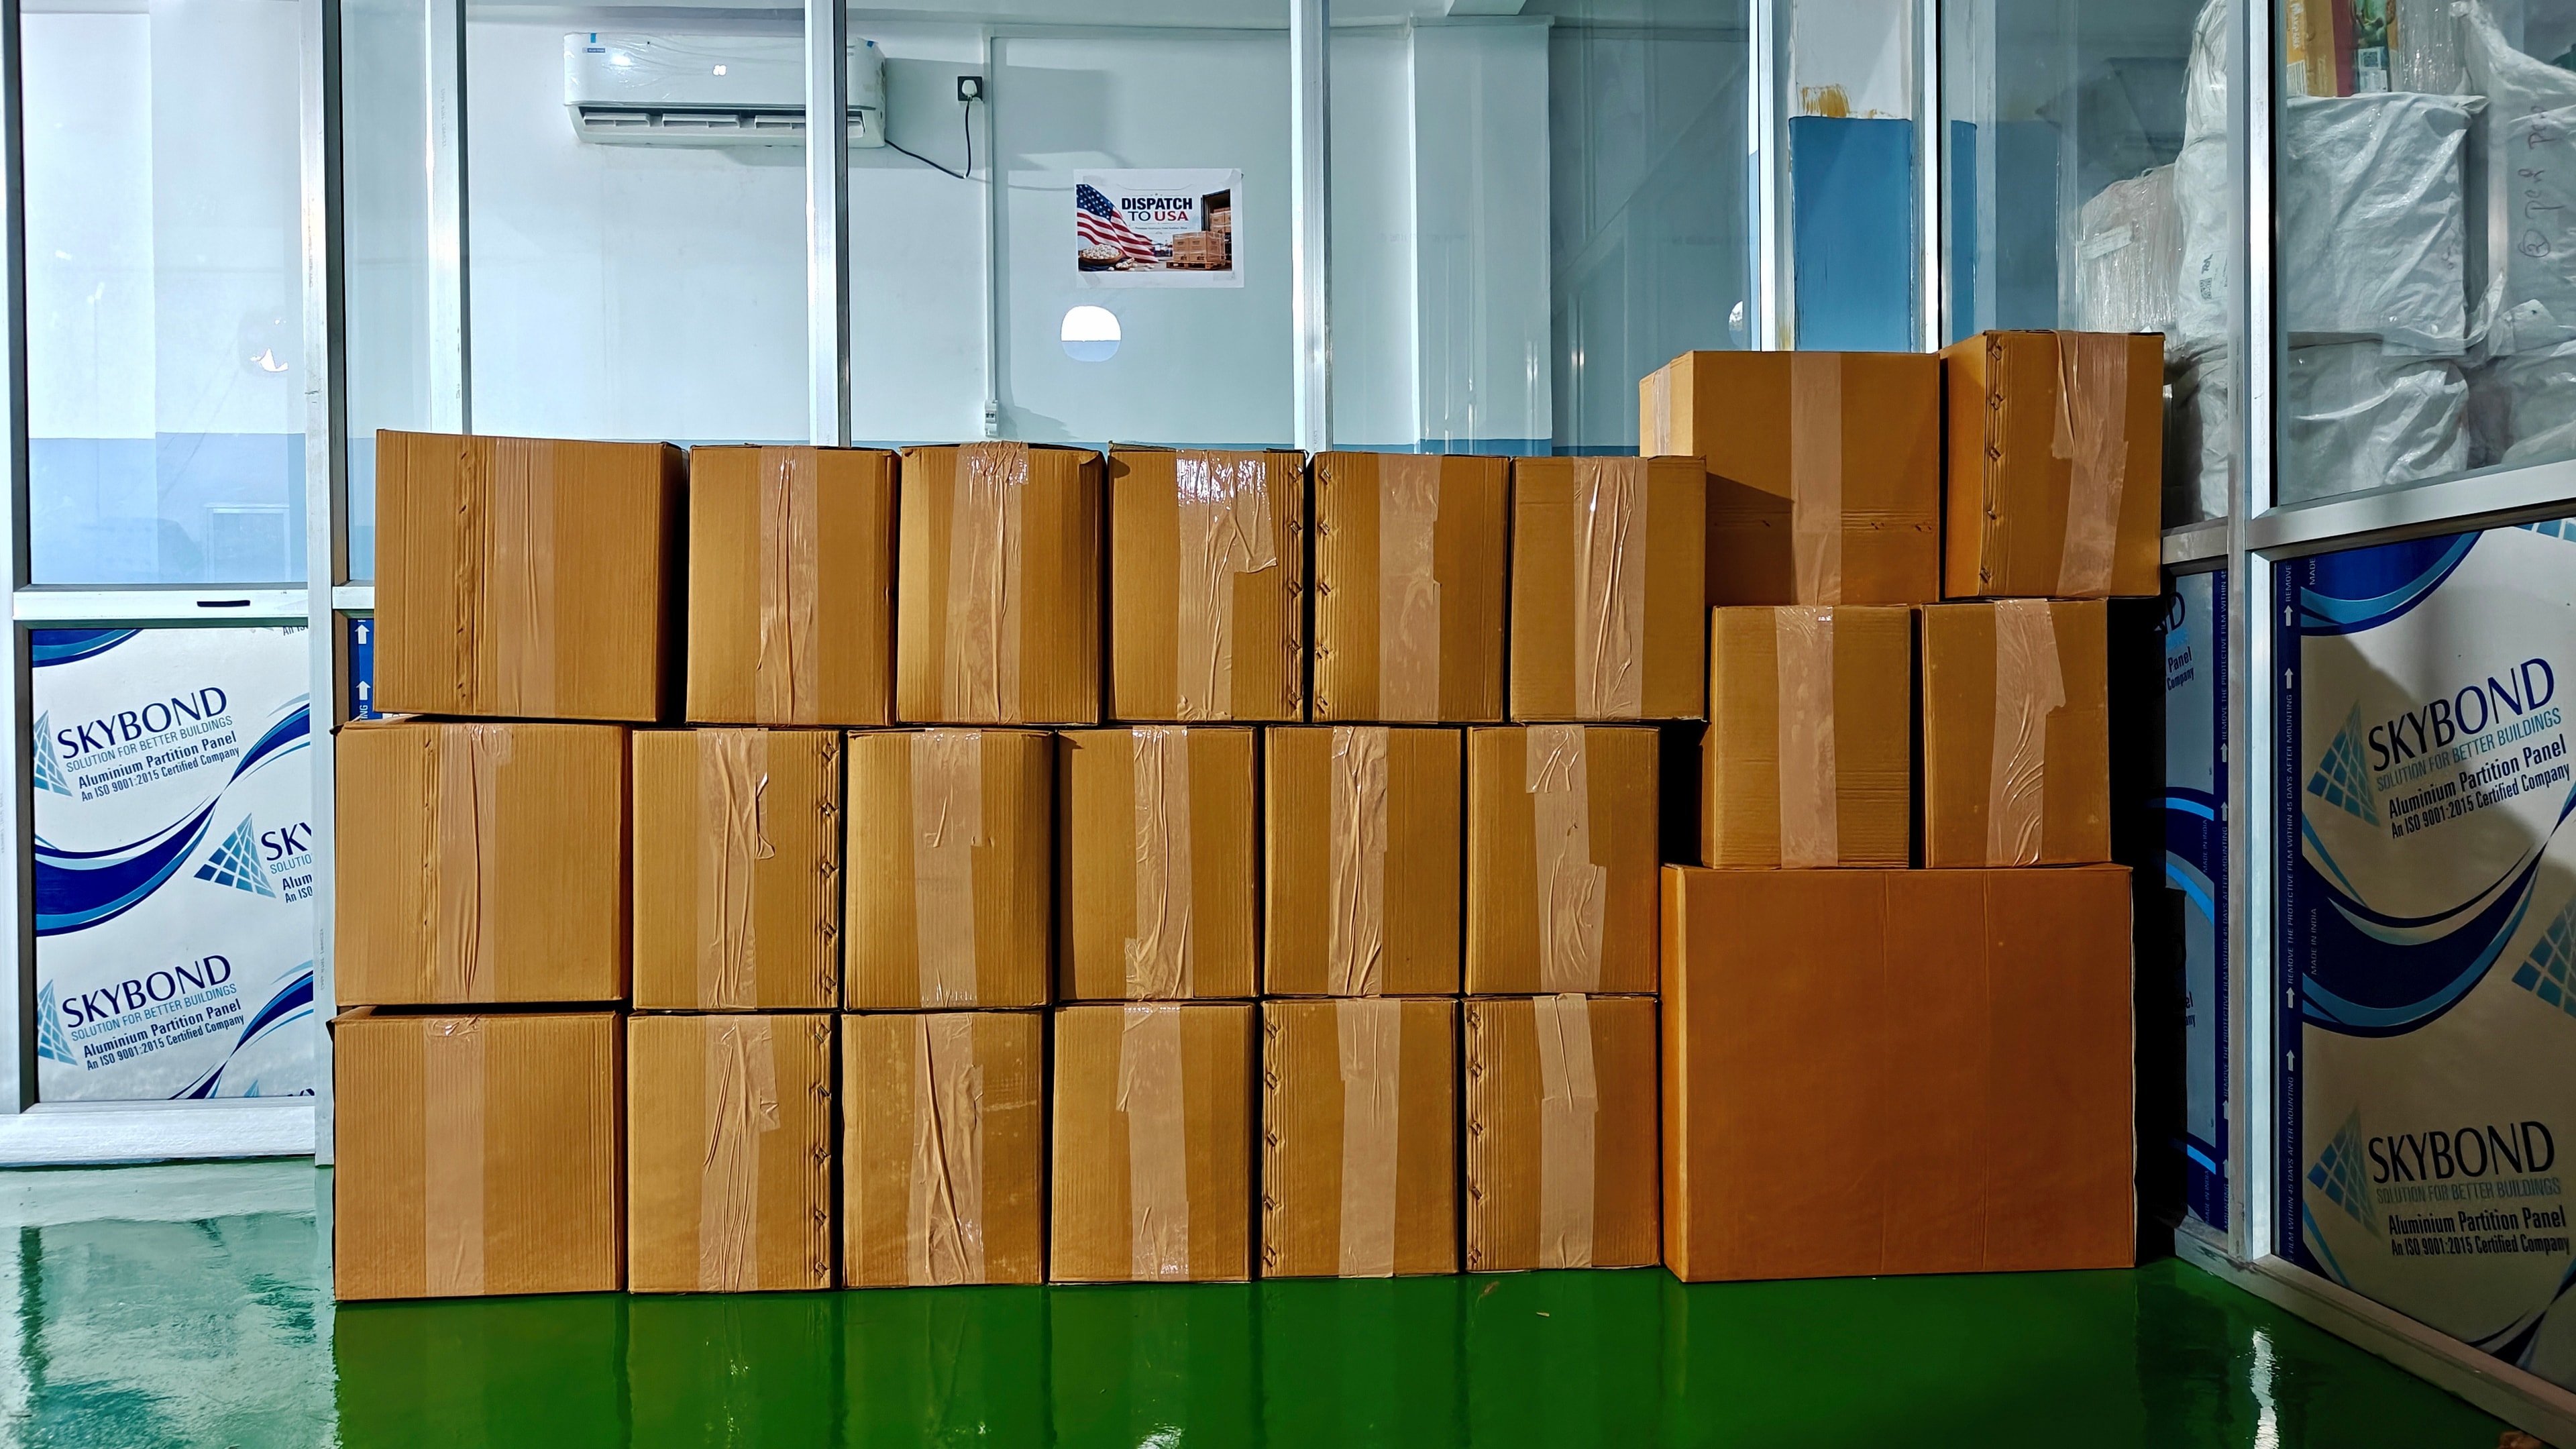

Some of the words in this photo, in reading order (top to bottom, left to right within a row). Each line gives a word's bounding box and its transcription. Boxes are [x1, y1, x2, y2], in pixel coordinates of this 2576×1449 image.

[1122, 197, 1193, 210] DISPATCH
[1127, 211, 1151, 221] TO
[1155, 211, 1189, 221] USA
[2167, 646, 2192, 673] Panel
[2167, 667, 2194, 691] Company
[58, 687, 227, 759] SKYBOND
[2368, 658, 2555, 771] SKYBOND
[66, 749, 115, 773] SOLUTION
[117, 743, 137, 757] FOR
[140, 732, 178, 751] BETTER
[180, 715, 233, 739] BUILDINGS
[79, 760, 144, 789] Aluminium
[146, 745, 199, 768] Partition
[202, 731, 236, 751] Panel
[2377, 759, 2426, 792] SOLUTION
[2428, 753, 2450, 772] FOR
[2453, 733, 2496, 763] BETTER
[2497, 707, 2562, 746] BUILDINGS
[81, 790, 93, 802] An
[95, 784, 110, 798] ISO
[113, 771, 159, 793] 9001:2015
[162, 757, 199, 777] Certified
[201, 747, 239, 766] Company
[2389, 779, 2457, 818] Aluminium
[2459, 757, 2520, 792] Partition
[2522, 733, 2567, 768] Panel
[2392, 823, 2404, 839] An
[2405, 814, 2421, 834] ISO
[2422, 795, 2474, 828] 9001:2015
[2476, 777, 2519, 808] Certified
[2521, 763, 2570, 792] Company
[2287, 802, 2293, 812] 45
[285, 892, 297, 903] An
[298, 885, 313, 899] ISO
[2310, 936, 2317, 945] IN
[62, 955, 231, 1028] SKYBOND
[71, 1018, 120, 1041] SOLUTION
[123, 1012, 142, 1026] FOR
[145, 1000, 182, 1020] BETTER
[184, 983, 237, 1007] BUILDINGS
[84, 1029, 148, 1058] Aluminium
[150, 1013, 203, 1037] Partition
[207, 998, 241, 1019] Panel
[87, 1059, 99, 1071] An
[101, 1053, 115, 1067] ISO
[118, 1039, 164, 1061] 9001:2015
[167, 1025, 203, 1045] Certified
[205, 1014, 244, 1034] Company
[2368, 1121, 2555, 1183] SKYBOND
[2288, 1183, 2294, 1195] 45
[2376, 1183, 2426, 1204] SOLUTION
[2428, 1183, 2449, 1201] FOR
[2451, 1181, 2494, 1202] BETTER
[2496, 1177, 2561, 1198] BUILDINGS
[2389, 1213, 2456, 1235] Aluminium
[2458, 1209, 2519, 1233] Partition
[2522, 1205, 2567, 1229] Panel
[2392, 1239, 2404, 1256] An
[2405, 1238, 2421, 1255] ISO
[2422, 1236, 2473, 1255] 9001:2015
[2475, 1234, 2518, 1254] Certified
[2520, 1234, 2570, 1256] Company
